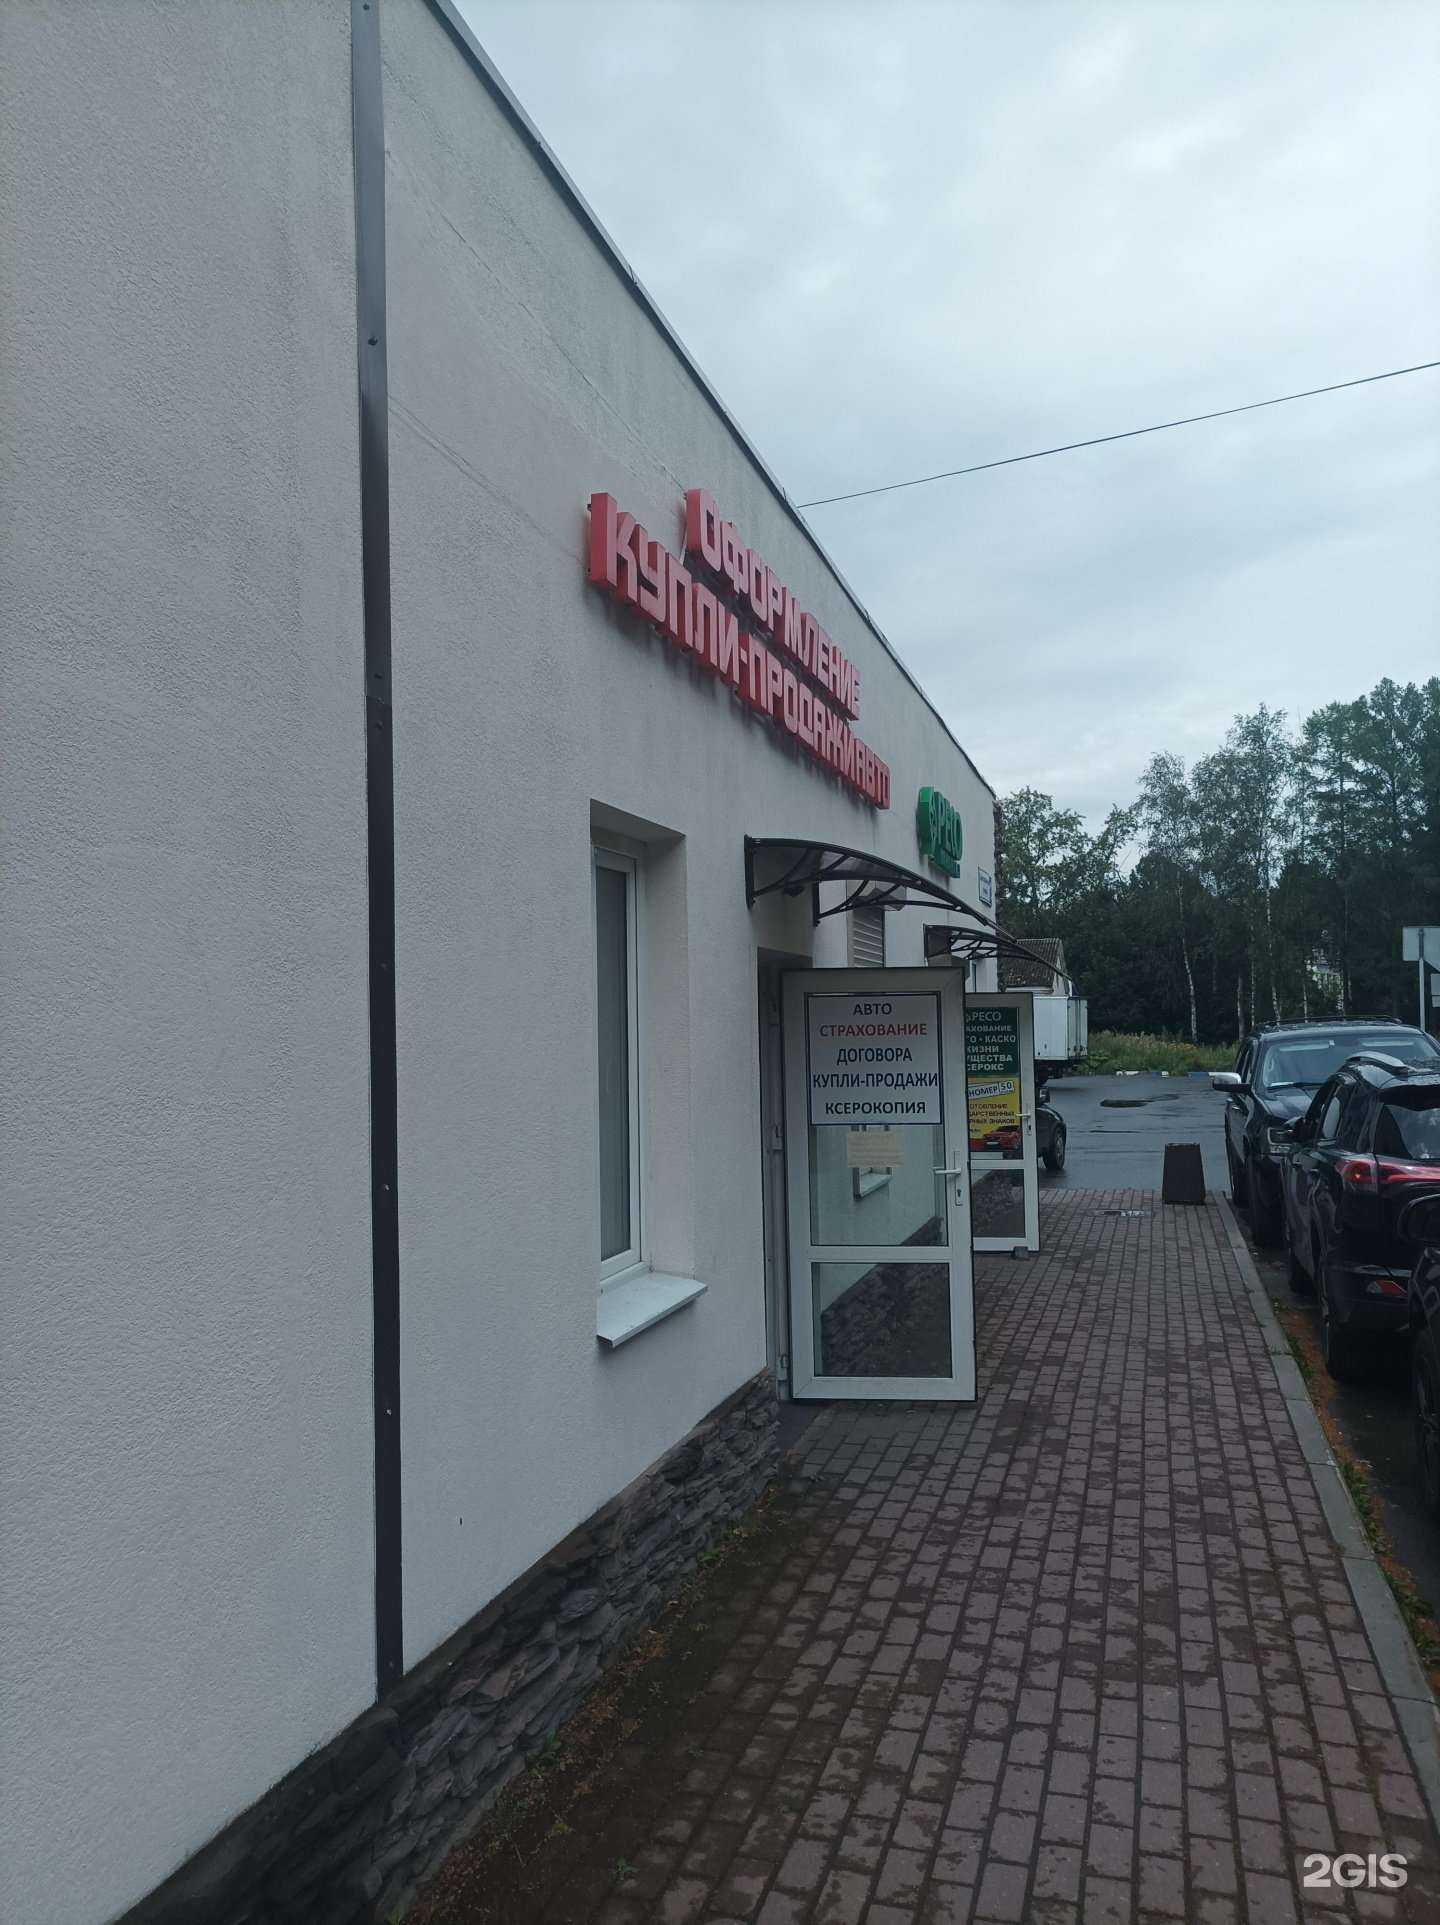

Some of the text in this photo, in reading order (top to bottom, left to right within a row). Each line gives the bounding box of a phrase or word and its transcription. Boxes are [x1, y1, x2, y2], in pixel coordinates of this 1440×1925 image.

[686, 488, 861, 720] ОФОРМЛЕНИЕ
[590, 492, 856, 781] КУПЛИ-ПРОДАЖИ
[853, 1003, 892, 1016] АВТО
[971, 1011, 1002, 1022] РЕСО
[819, 1023, 928, 1037] СТРАХОВАНИЕ
[984, 1035, 1016, 1043] КАСКО
[836, 1047, 913, 1066] ДОГОВОРА
[812, 1072, 938, 1090] КУПЛИ-ПРОДАЖИ
[1000, 1082, 1012, 1090] 50
[825, 1101, 926, 1115] КСЕРОКОПИЯ
